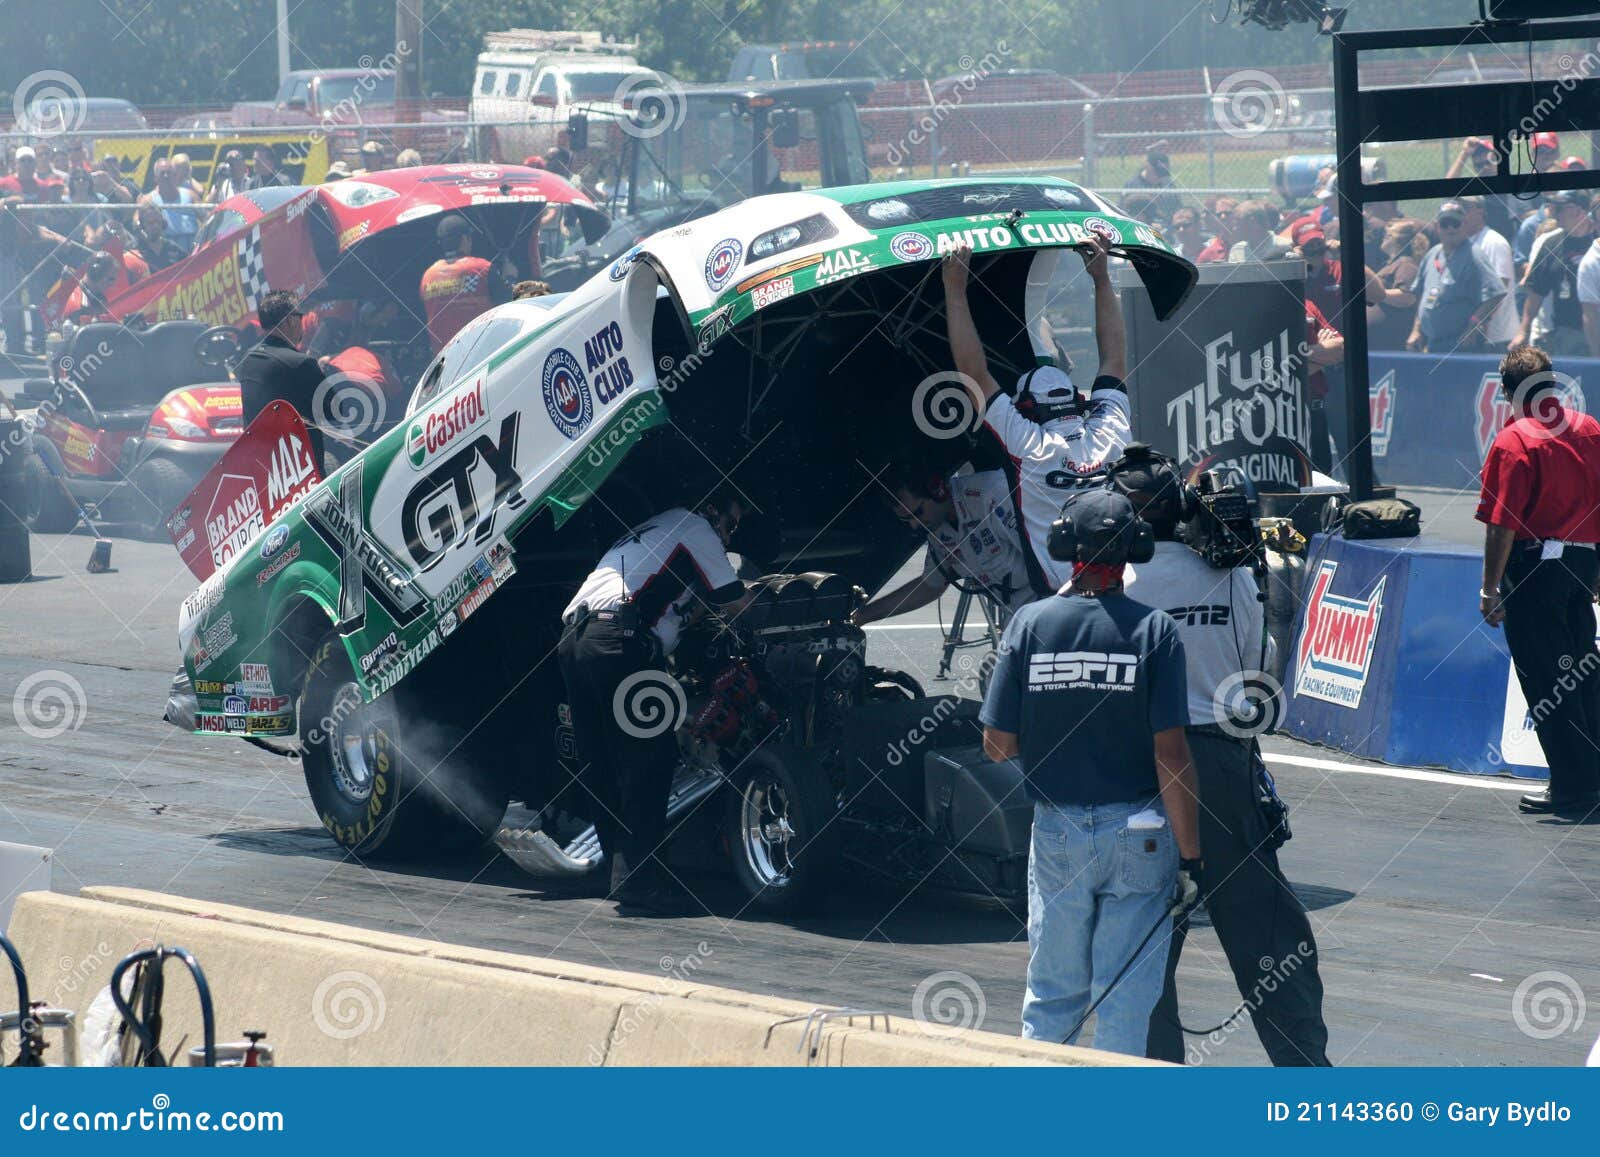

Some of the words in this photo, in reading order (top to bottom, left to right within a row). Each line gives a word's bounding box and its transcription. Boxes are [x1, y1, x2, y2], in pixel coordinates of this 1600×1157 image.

[937, 228, 1012, 255] AUTO
[1021, 223, 1084, 244] CLUB
[816, 249, 873, 279] MAC
[156, 254, 238, 322] Advance
[754, 279, 792, 300] BRAND
[584, 321, 623, 374] AUTO
[1204, 328, 1295, 406] Full
[544, 352, 565, 397] AUTOMOBILE
[556, 378, 577, 406] AAA
[594, 356, 634, 405] CLUB
[426, 379, 486, 454] Castrol
[267, 432, 315, 510] MAC
[402, 411, 528, 574] GTX
[208, 487, 259, 546] BRAND
[320, 499, 361, 551] JOHN
[264, 529, 286, 556] Ford
[187, 574, 225, 620] Whirlpool
[433, 569, 471, 618] NORDIC
[1300, 573, 1377, 669] SUMMIT
[1028, 651, 1138, 684] ESPN
[1028, 684, 1042, 692] THE
[1044, 683, 1068, 691] TOTAL
[1069, 682, 1096, 690] SPORTS
[1097, 682, 1135, 692] NETWORK
[249, 696, 289, 712] ARP
[1303, 676, 1327, 695] RACING
[1324, 681, 1361, 705] EQUIPMENT
[203, 715, 225, 731] MSD
[226, 717, 246, 729] WELD
